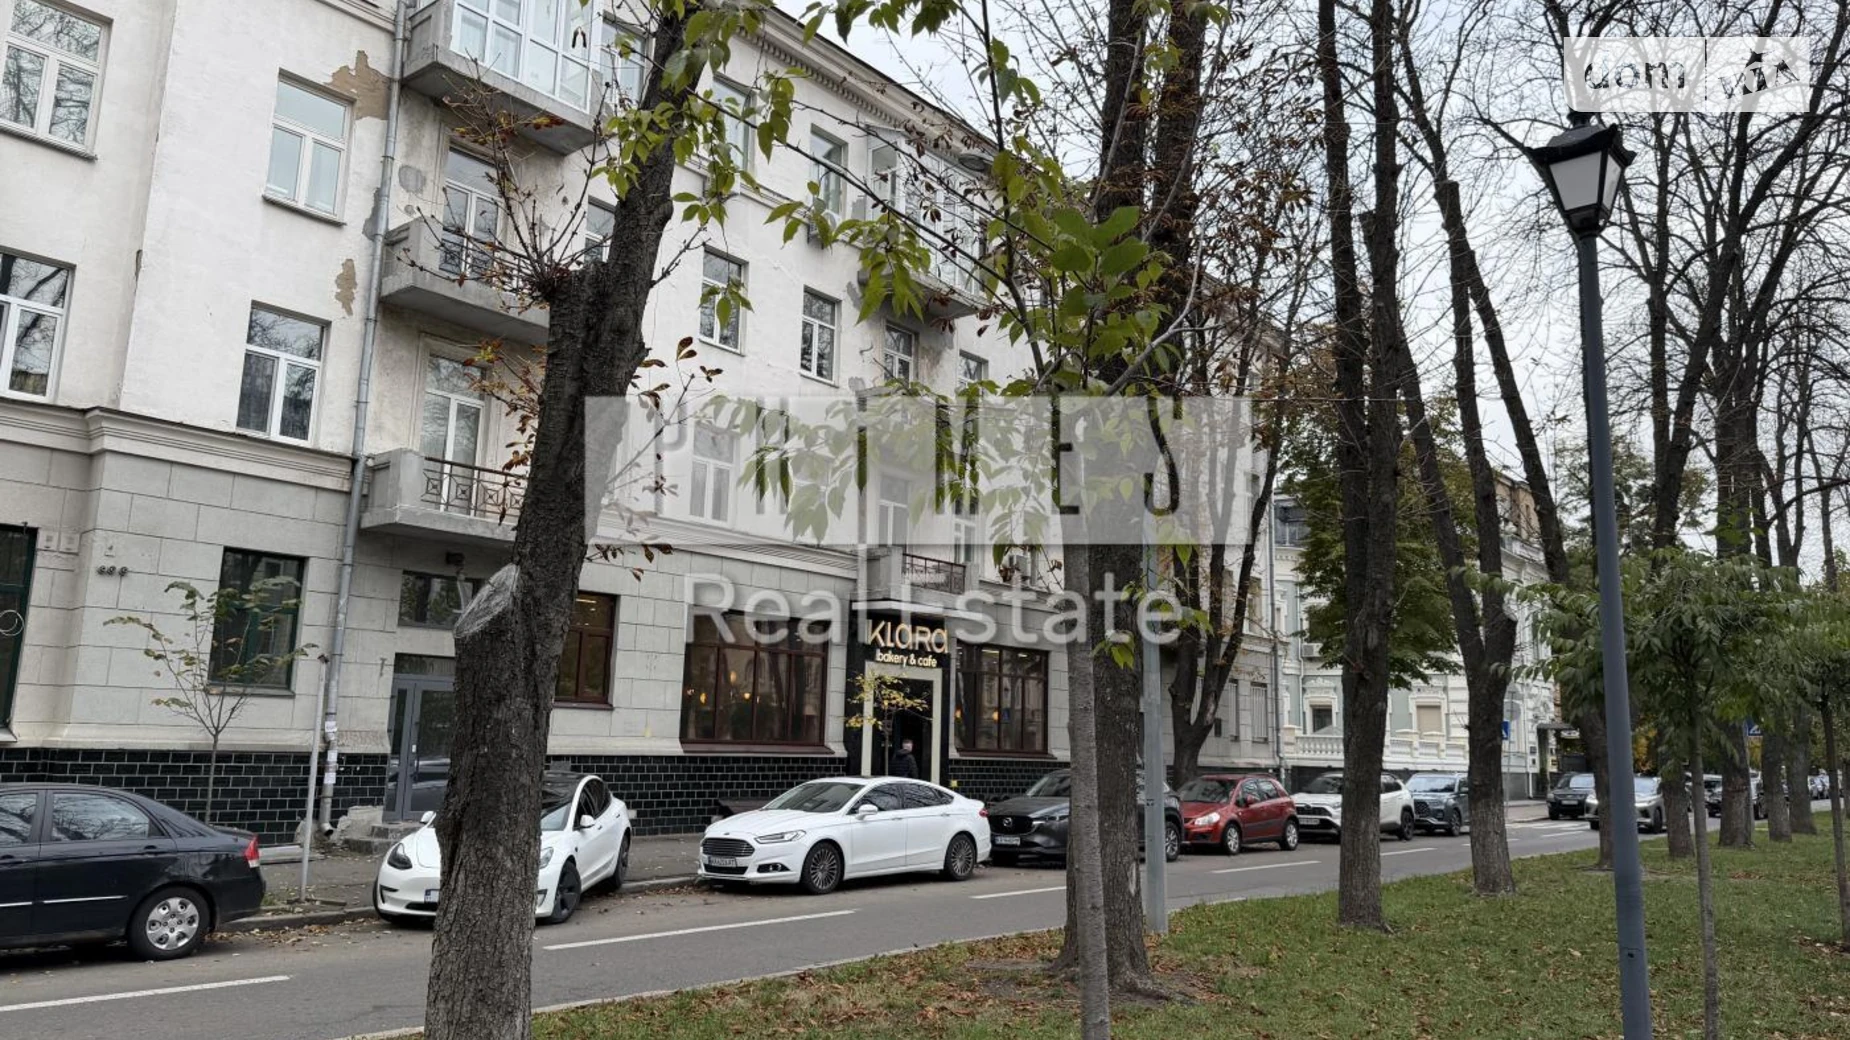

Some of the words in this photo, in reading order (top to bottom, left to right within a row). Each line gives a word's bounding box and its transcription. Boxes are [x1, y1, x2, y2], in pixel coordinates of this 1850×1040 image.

[876, 648, 908, 668] bakery
[909, 653, 917, 665] &
[918, 655, 938, 668] cafe
